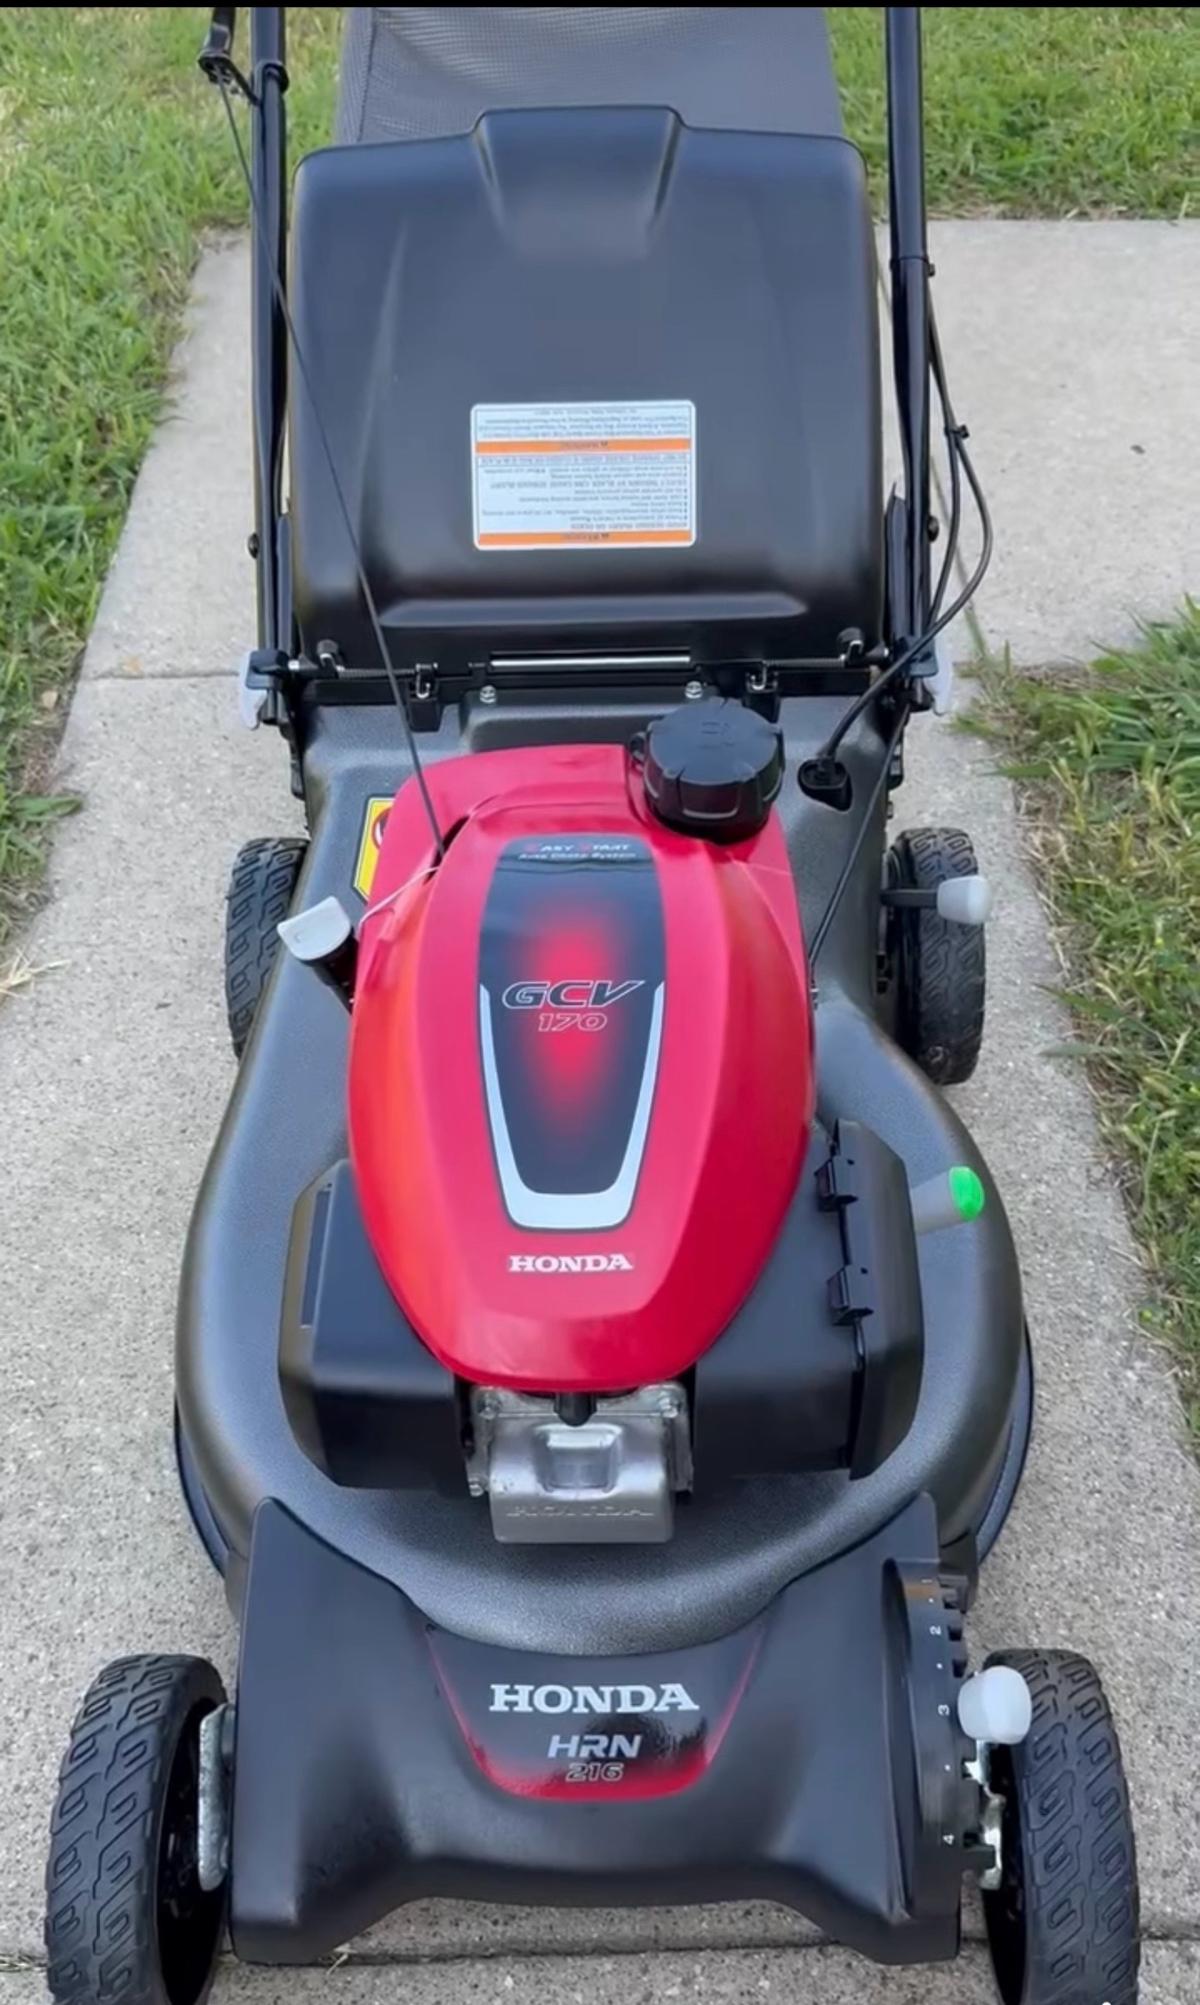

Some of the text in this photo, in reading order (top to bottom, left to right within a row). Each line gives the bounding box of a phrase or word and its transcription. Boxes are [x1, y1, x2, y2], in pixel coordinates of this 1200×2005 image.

[523, 842, 629, 852] ASY TART
[502, 980, 645, 1009] GCV
[538, 1013, 607, 1032] 170
[509, 1254, 633, 1272] HONDA
[929, 1625, 942, 1635] 2
[489, 1683, 699, 1714] HONDA
[938, 1704, 950, 1716] 3
[547, 1734, 642, 1758] HRN
[565, 1762, 624, 1782] 216
[942, 1834, 955, 1845] 4
